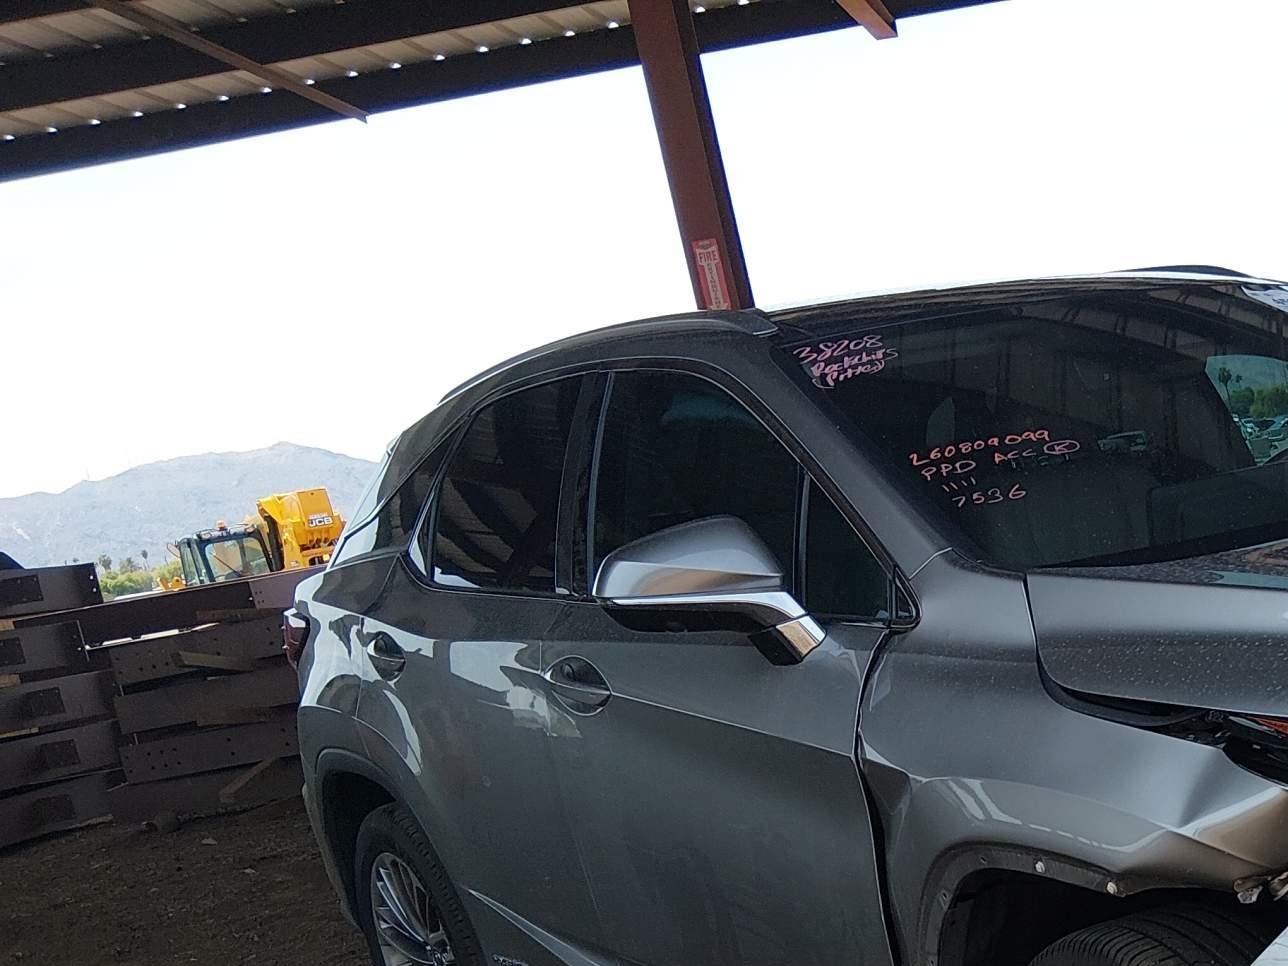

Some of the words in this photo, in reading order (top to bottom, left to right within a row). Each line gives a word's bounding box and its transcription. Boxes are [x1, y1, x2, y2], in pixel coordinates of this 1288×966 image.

[792, 334, 883, 365] 38208
[921, 460, 977, 481] PPD
[994, 449, 1037, 465] ACC
[952, 483, 1027, 508] 7536
[308, 517, 333, 527] JCB
